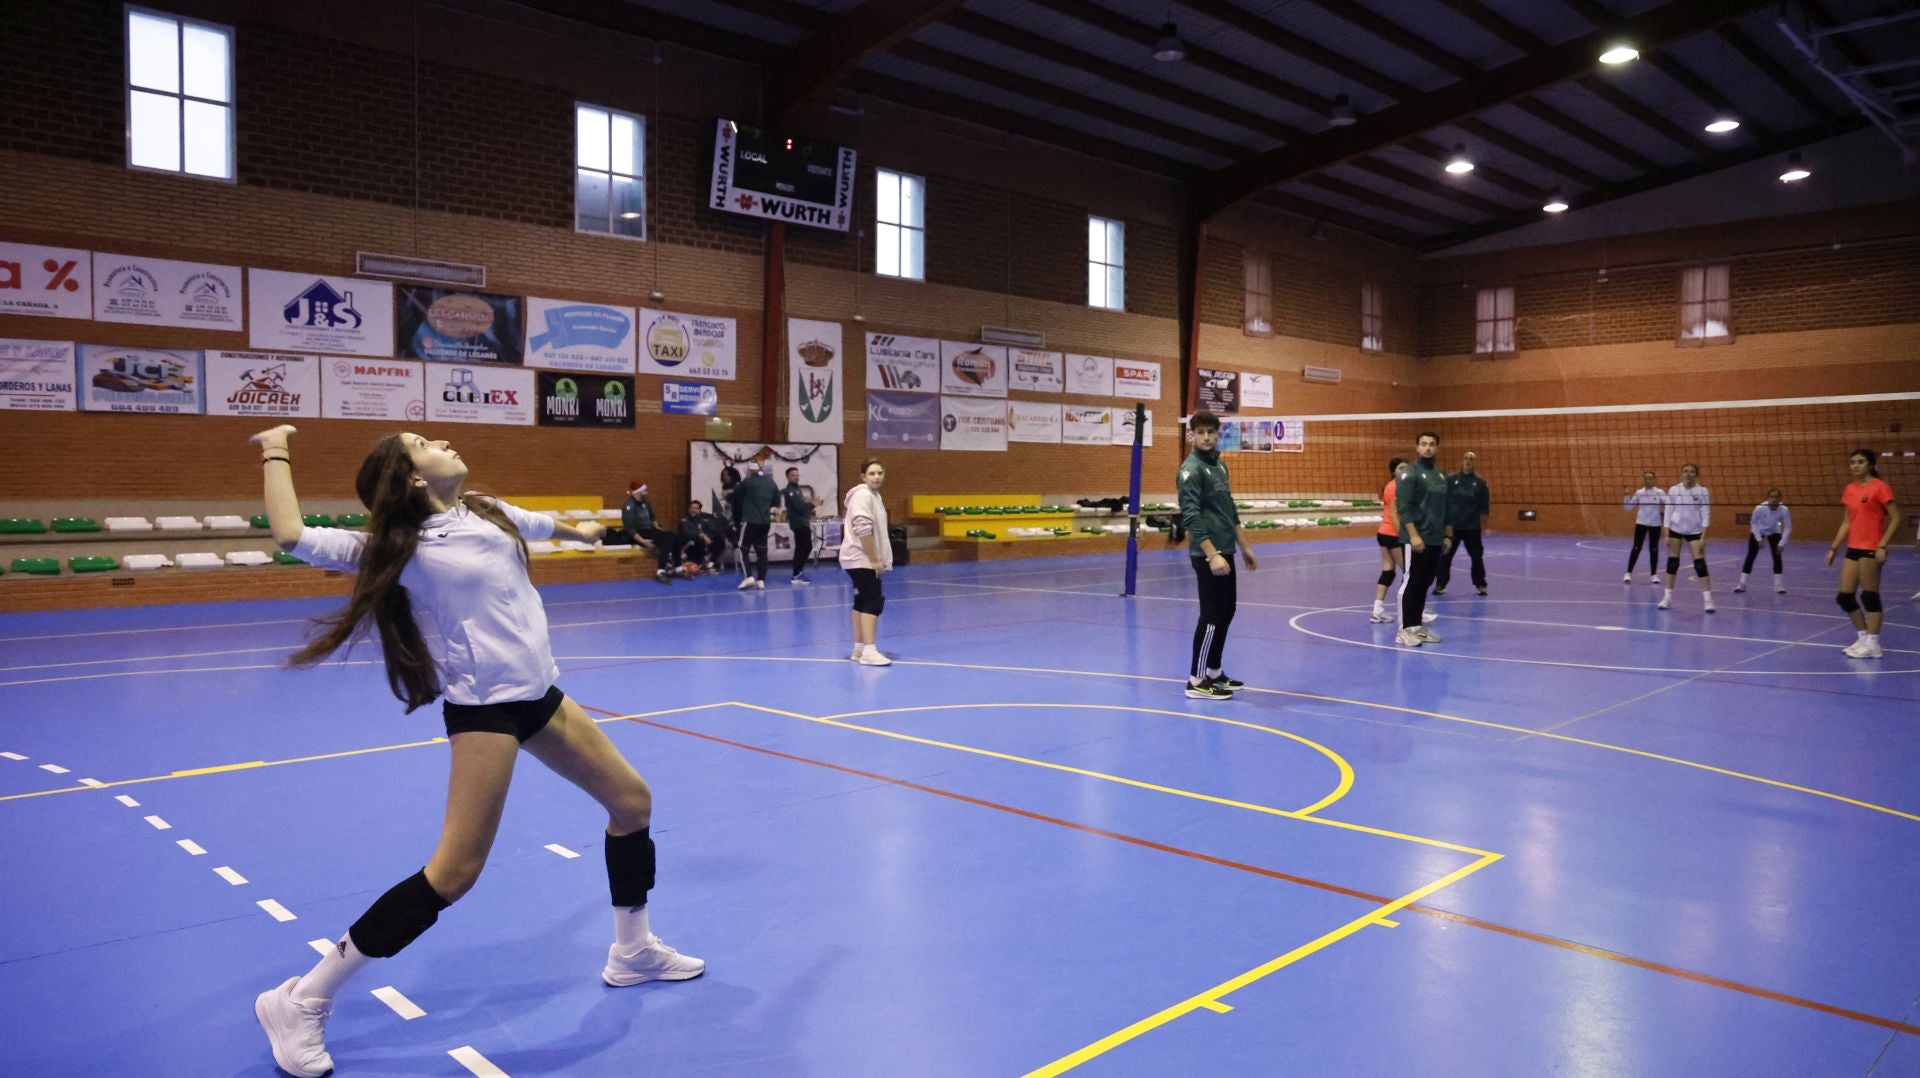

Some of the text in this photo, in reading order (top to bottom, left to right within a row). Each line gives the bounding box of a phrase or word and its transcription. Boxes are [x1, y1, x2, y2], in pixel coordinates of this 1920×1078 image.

[740, 150, 768, 164] LOCAL
[653, 344, 683, 358] TAXI
[869, 347, 911, 358] Lusitania
[354, 366, 412, 377] MAPFRE
[37, 382, 44, 391] Y
[46, 383, 72, 393] LANAS
